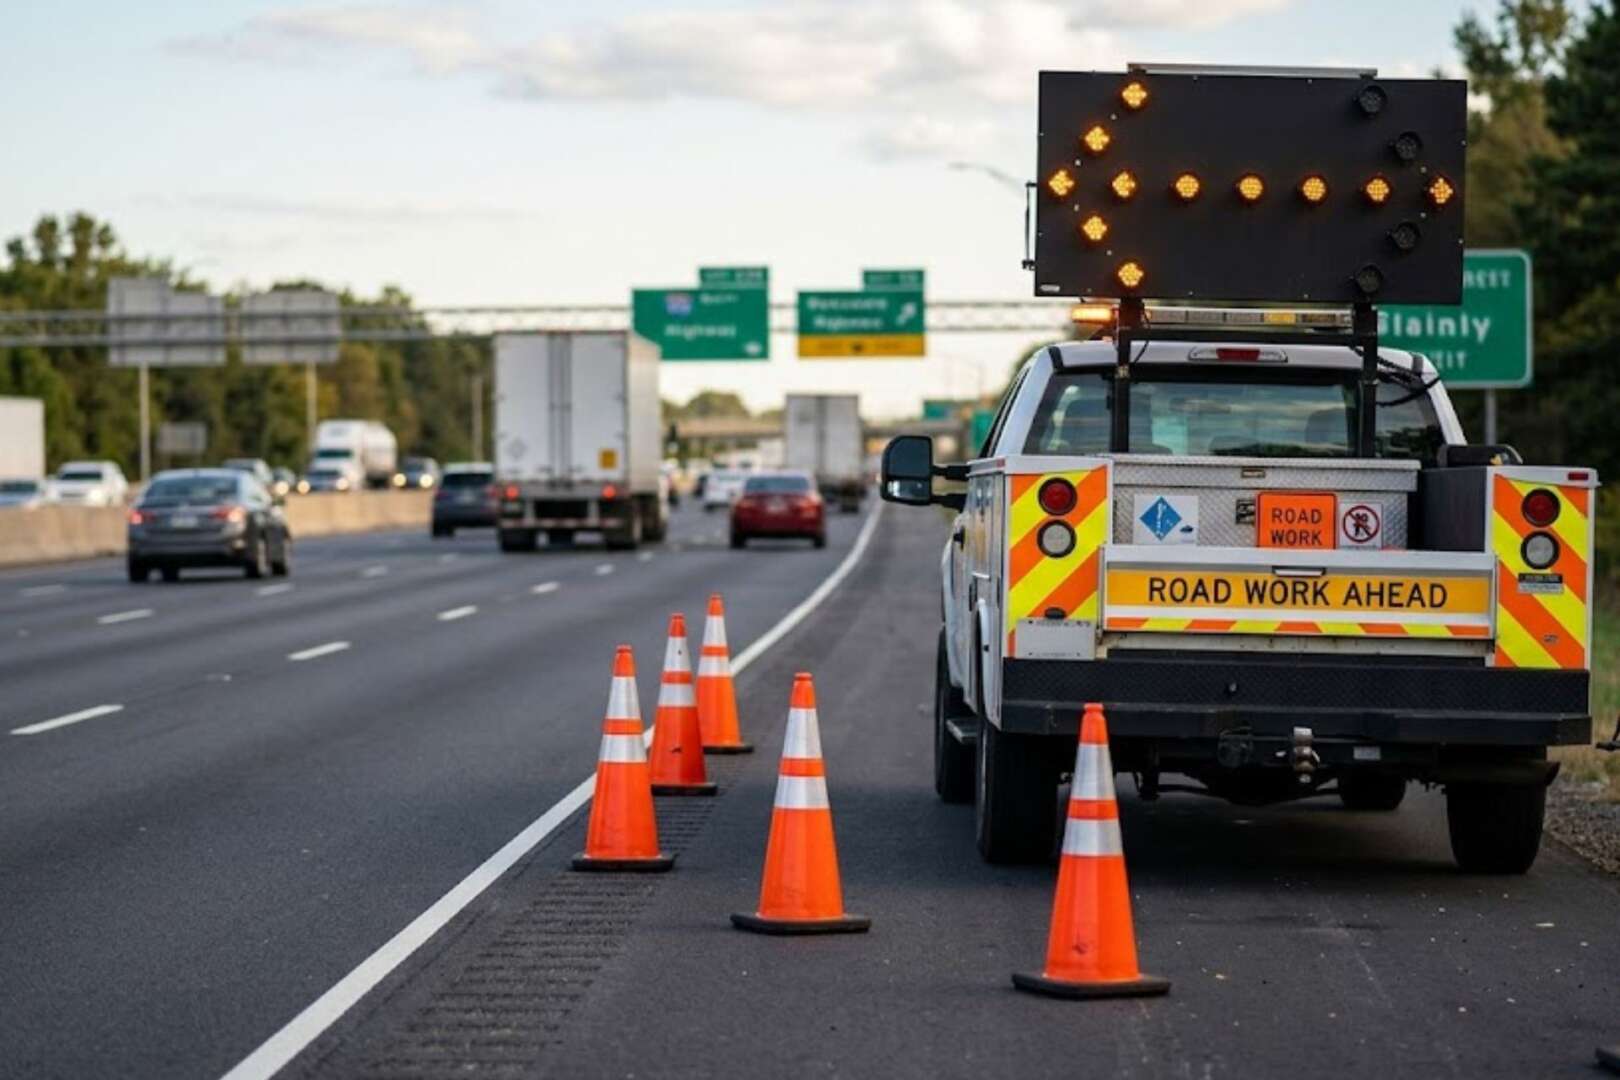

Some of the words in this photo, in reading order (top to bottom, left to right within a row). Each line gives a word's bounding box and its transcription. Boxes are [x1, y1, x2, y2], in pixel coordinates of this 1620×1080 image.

[1271, 507, 1323, 525] ROAD
[1271, 528, 1323, 546] WORK
[1149, 577, 1232, 603] ROAD
[1244, 579, 1330, 607] WORK
[1342, 582, 1448, 609] AHEAD
